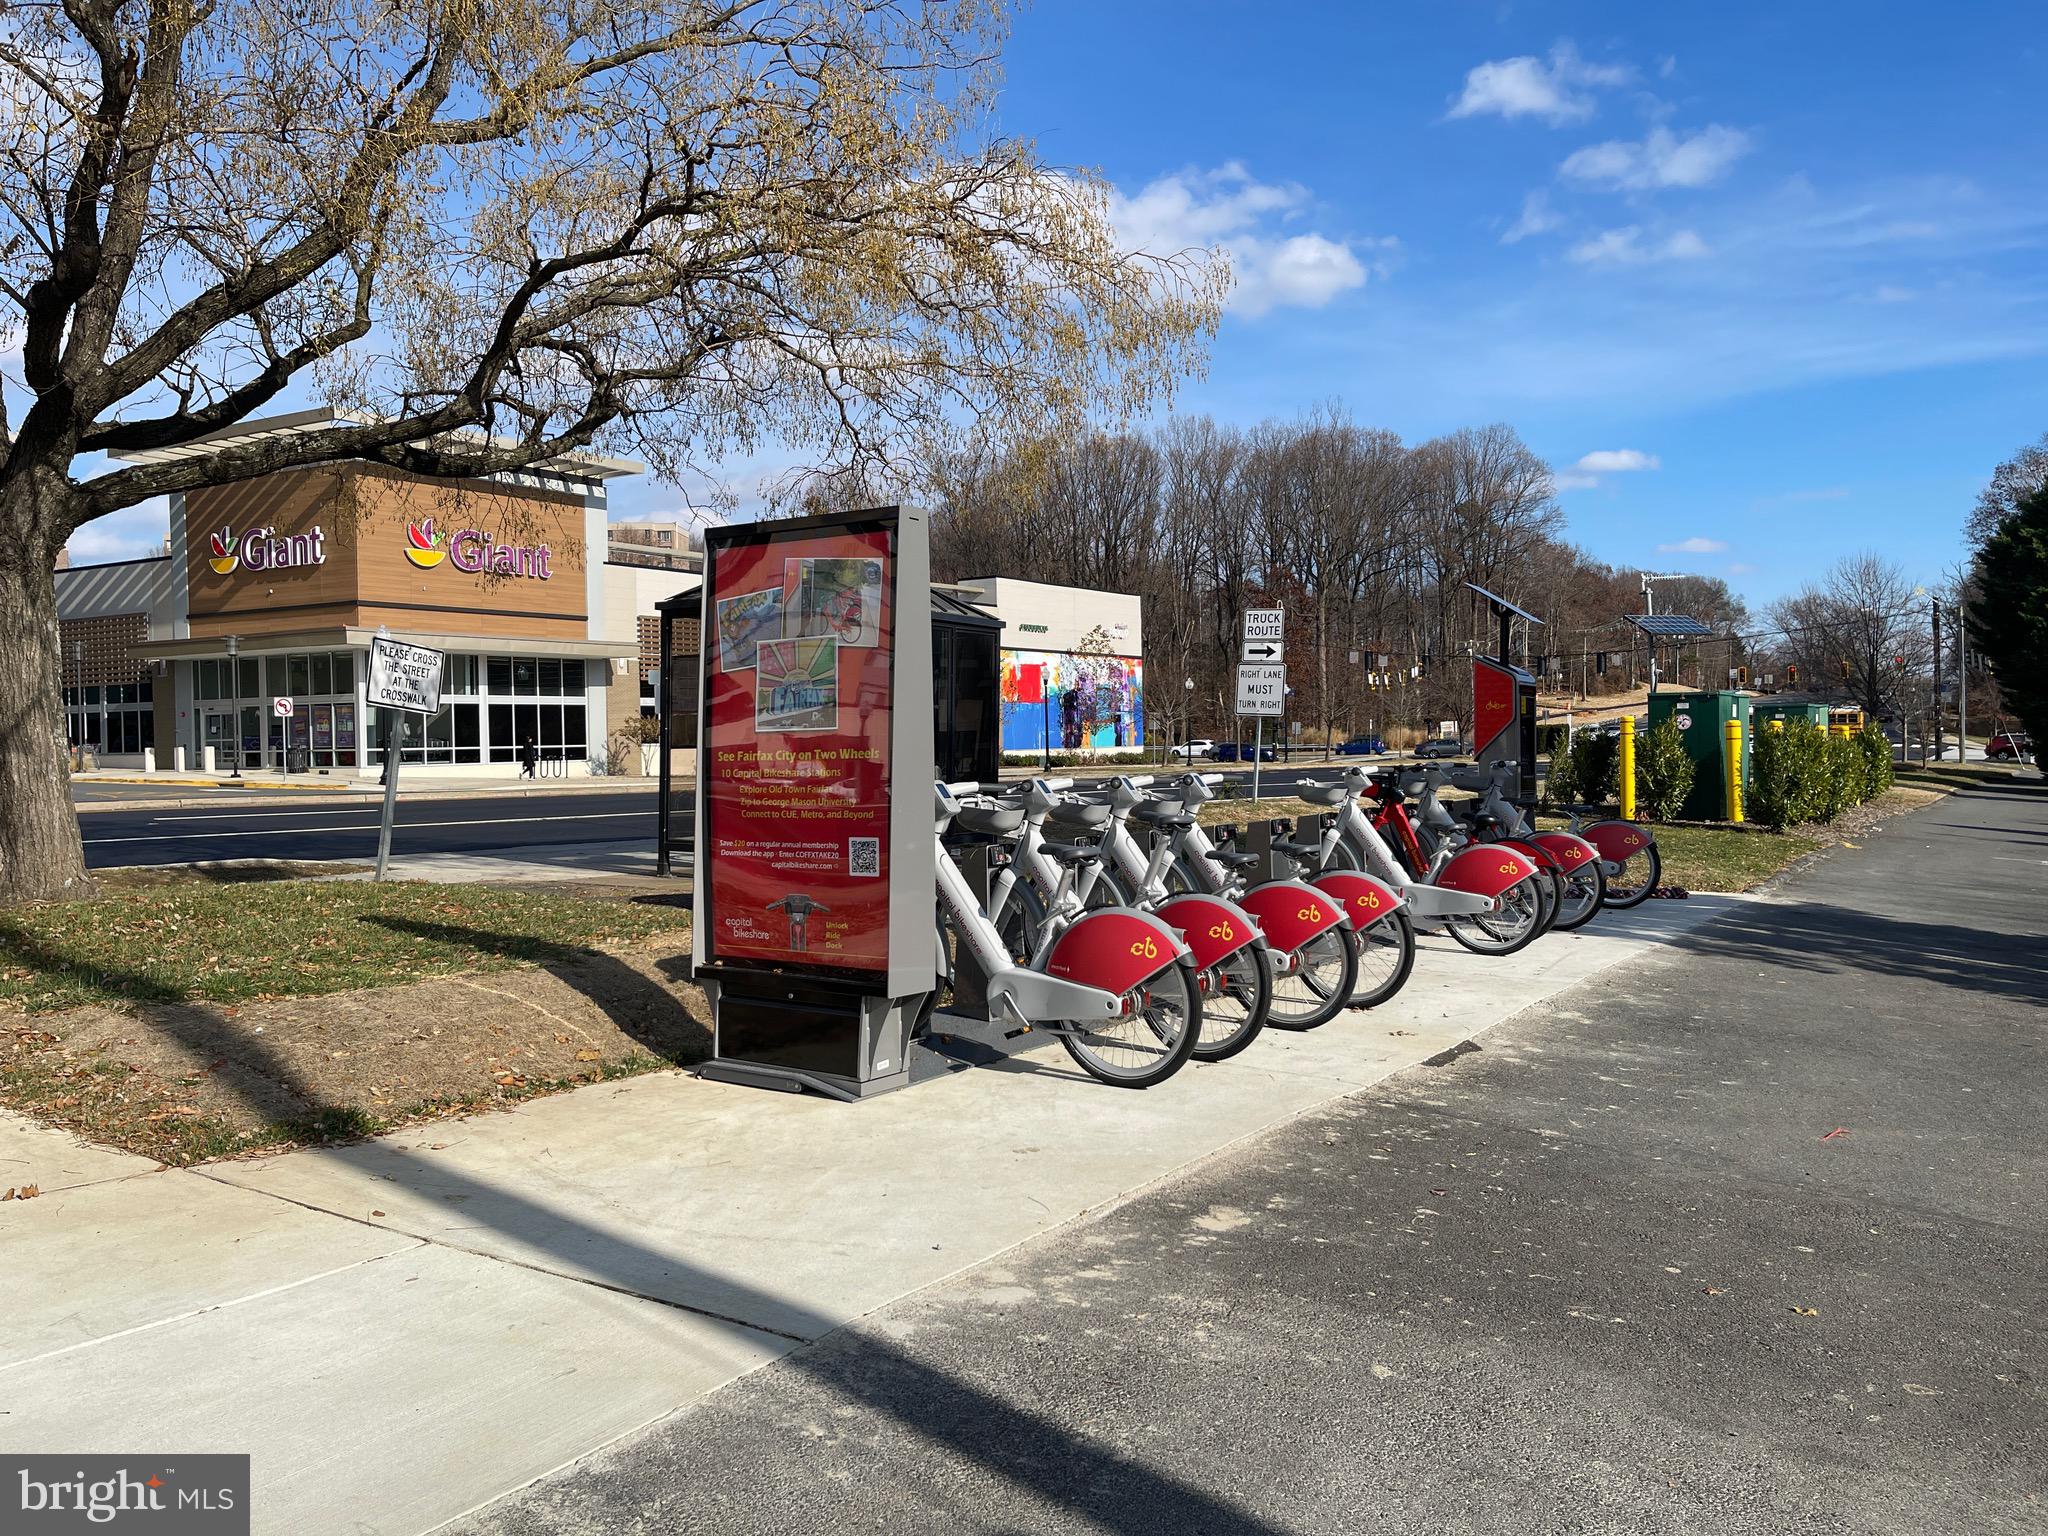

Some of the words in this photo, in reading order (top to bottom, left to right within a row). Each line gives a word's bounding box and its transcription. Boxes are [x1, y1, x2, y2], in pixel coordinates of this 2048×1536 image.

[240, 525, 326, 571] Giant
[450, 529, 554, 579] Giant
[1247, 613, 1281, 624] TRUCK
[1247, 626, 1281, 636] ROUTE
[379, 645, 410, 661] PLEASE
[412, 651, 438, 667] CROSS
[384, 660, 399, 673] THE
[402, 664, 430, 679] STREET
[1240, 670, 1260, 679] RIGHT
[1264, 670, 1282, 679] LANE
[392, 676, 402, 687] AT
[405, 678, 420, 691] THE
[1247, 684, 1273, 695] MUST
[381, 688, 427, 706] CROSSWALK
[1239, 699, 1256, 709] TURN
[1260, 700, 1281, 709] RIGHT
[718, 751, 735, 762] See
[737, 750, 773, 762] Fairfax
[775, 749, 796, 763] City
[798, 751, 812, 760] on
[814, 749, 836, 760] Two
[839, 748, 880, 760] Wheels
[721, 769, 731, 778] 10
[732, 768, 761, 780] Capital
[764, 768, 804, 778] Bikeshare
[807, 768, 841, 778] Stations
[739, 785, 767, 795] Explore
[768, 785, 782, 794] Old
[784, 785, 805, 794] Town
[740, 798, 751, 808] Zip
[753, 798, 761, 806] to
[762, 798, 790, 808] George
[792, 798, 817, 807] Mason
[818, 797, 857, 808] University
[741, 810, 771, 819] Connect
[772, 811, 779, 819] to
[781, 810, 798, 820] CUE,
[800, 810, 825, 820] Metro,
[826, 809, 842, 819] and
[842, 810, 874, 821] Beyond
[719, 839, 734, 848] Save
[734, 839, 746, 848] $20
[760, 841, 780, 849] regular
[781, 841, 801, 849] annual
[801, 841, 839, 851] membership
[721, 849, 751, 858] Download
[752, 849, 762, 858] the
[762, 851, 775, 860] app
[778, 850, 795, 859] Enter
[771, 861, 833, 871] capitalbikeshare.com
[725, 917, 753, 928] capital
[825, 921, 849, 930] Unlock
[733, 928, 770, 940] bikeshare
[825, 931, 841, 940] Ride
[954, 908, 982, 956] bikeshare
[825, 942, 843, 950] Dock
